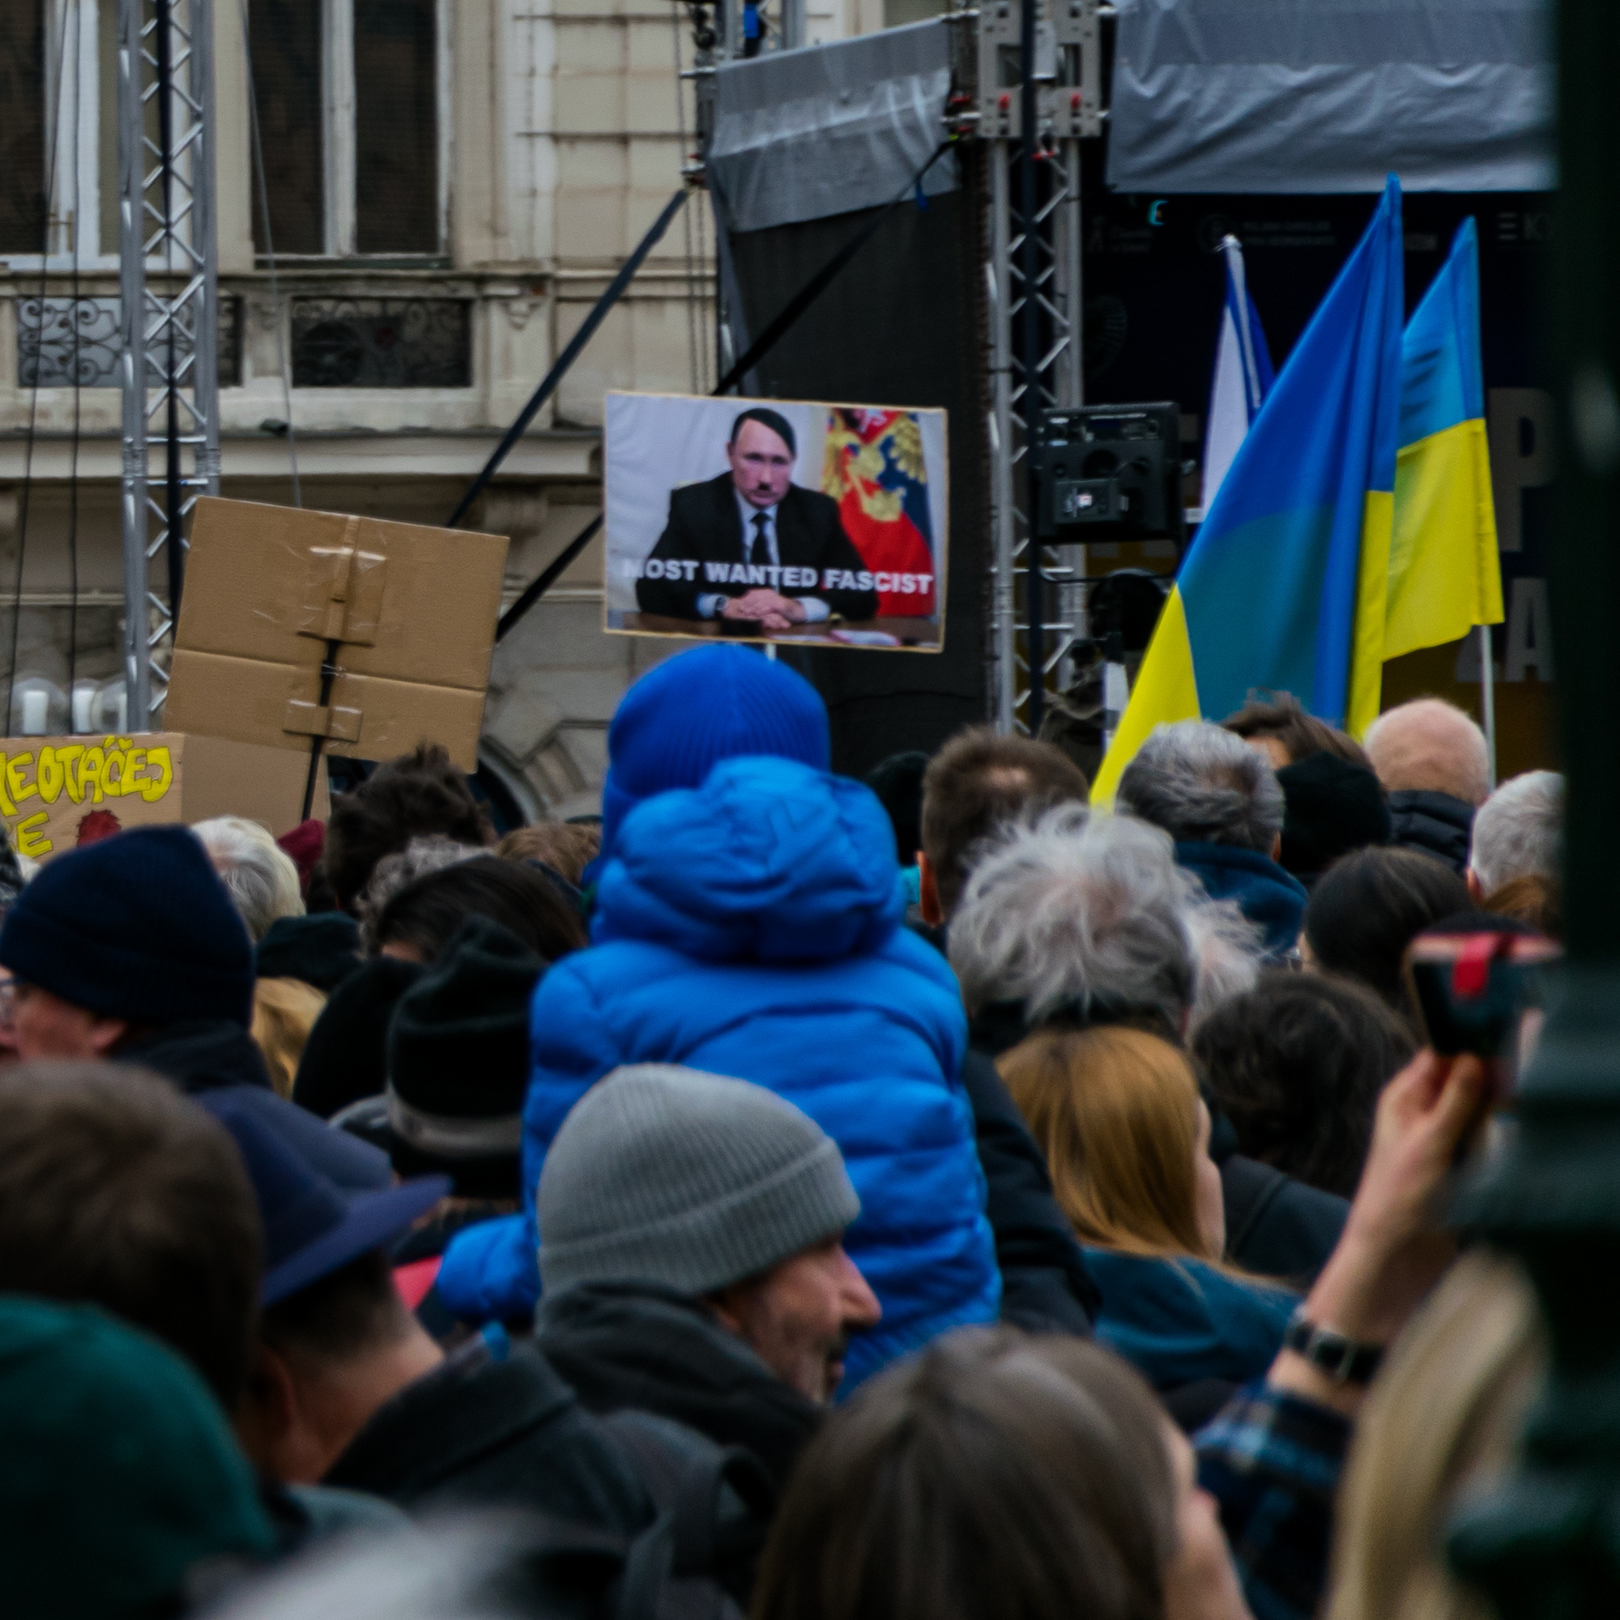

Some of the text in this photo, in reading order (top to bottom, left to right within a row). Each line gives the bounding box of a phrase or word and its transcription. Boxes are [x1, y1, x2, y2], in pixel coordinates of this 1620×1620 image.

[623, 558, 934, 594] MOST WANTED FASCIST
